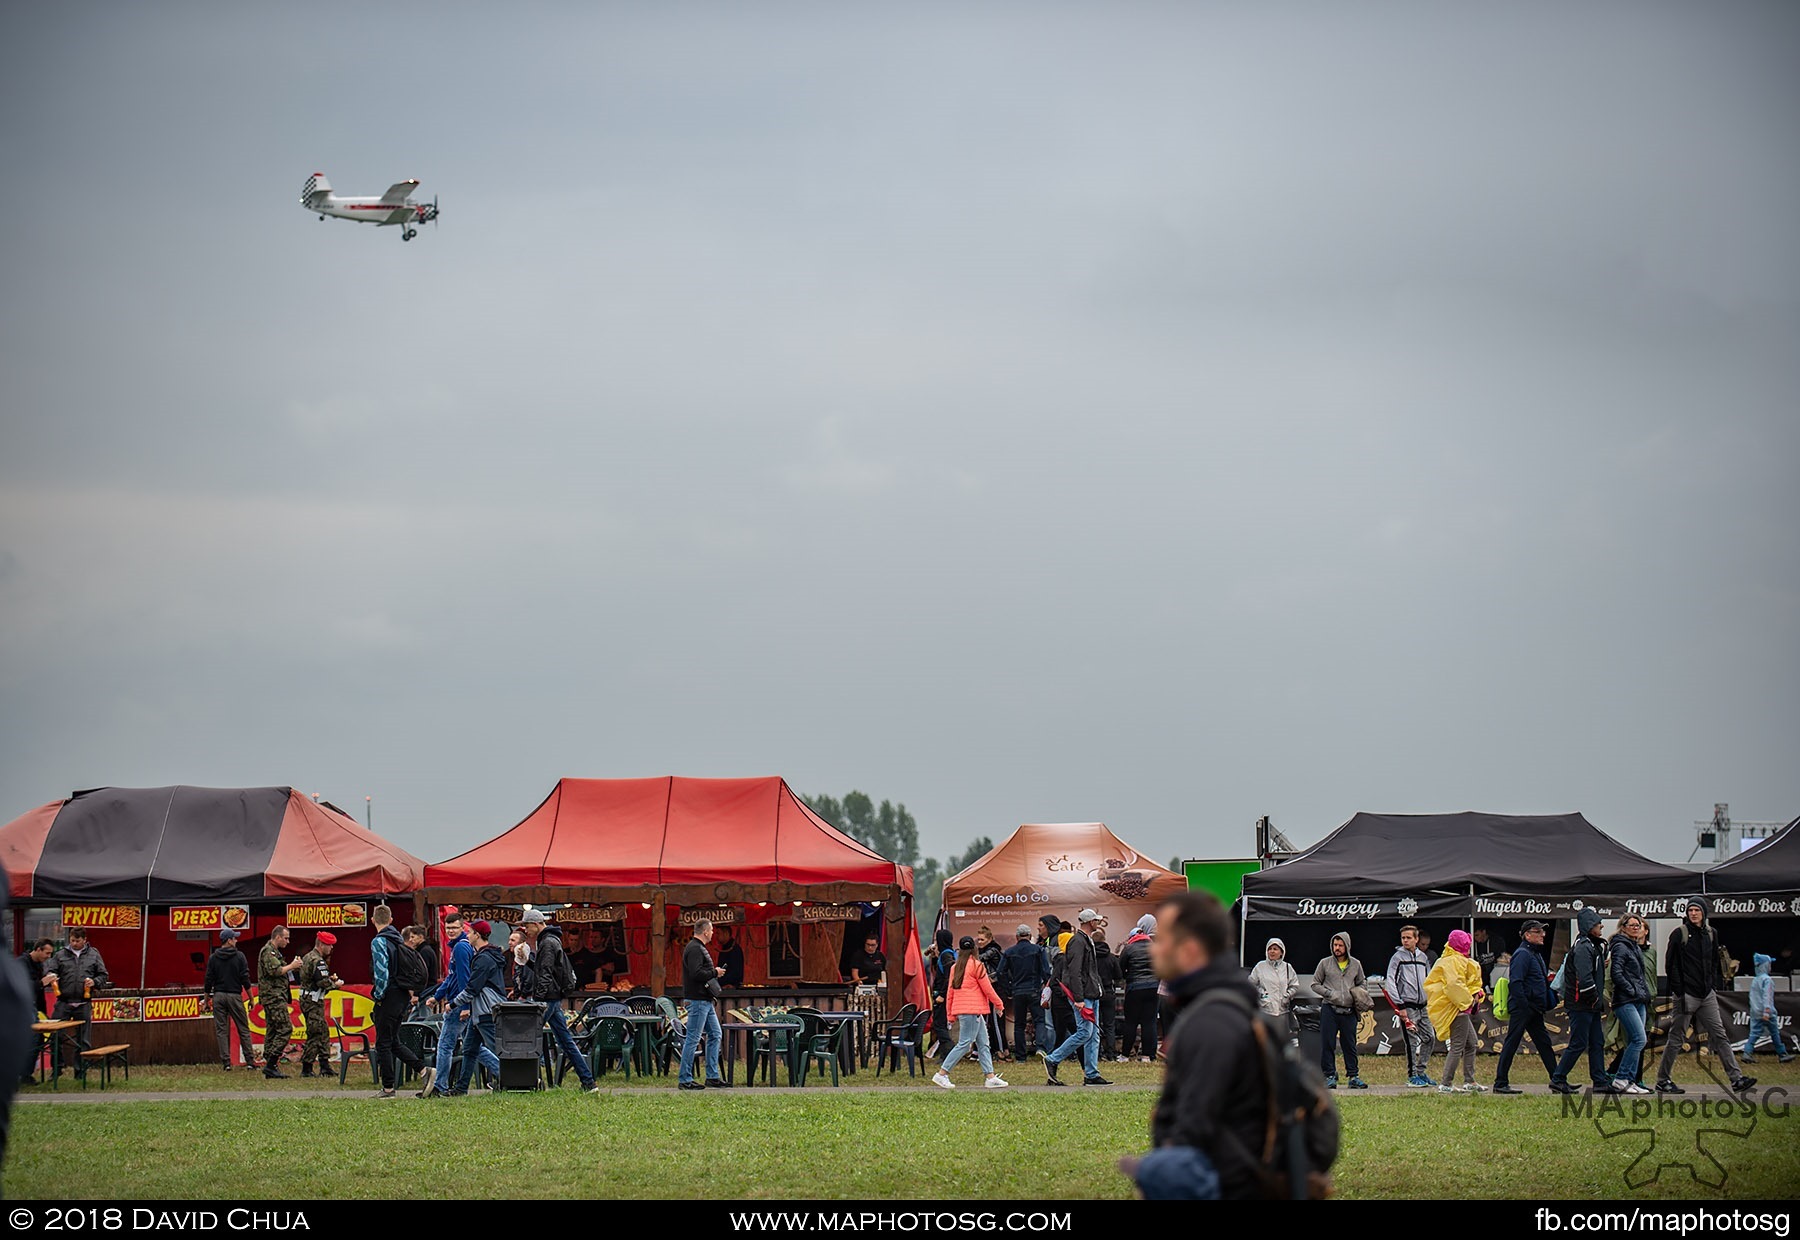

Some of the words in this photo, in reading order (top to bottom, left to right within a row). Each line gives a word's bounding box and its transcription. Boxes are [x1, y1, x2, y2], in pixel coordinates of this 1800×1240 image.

[972, 893, 1013, 905] Coffee
[1016, 893, 1028, 903] to
[1030, 892, 1050, 903] Go
[1475, 898, 1522, 917] Nugets
[1524, 898, 1552, 914] Box
[1712, 898, 1756, 914] Kebab
[1758, 897, 1787, 913] Box
[63, 906, 115, 926] FRYTKI
[173, 907, 220, 925] PIERŚ
[288, 905, 342, 925] HAMBURGER
[558, 909, 611, 922] KIEŁBASA
[683, 910, 735, 923] GOLONKA
[803, 906, 854, 919] KARCZEK
[1296, 898, 1381, 920] Burgery
[1625, 899, 1668, 918] Frytki
[145, 997, 198, 1019] GOLONKA
